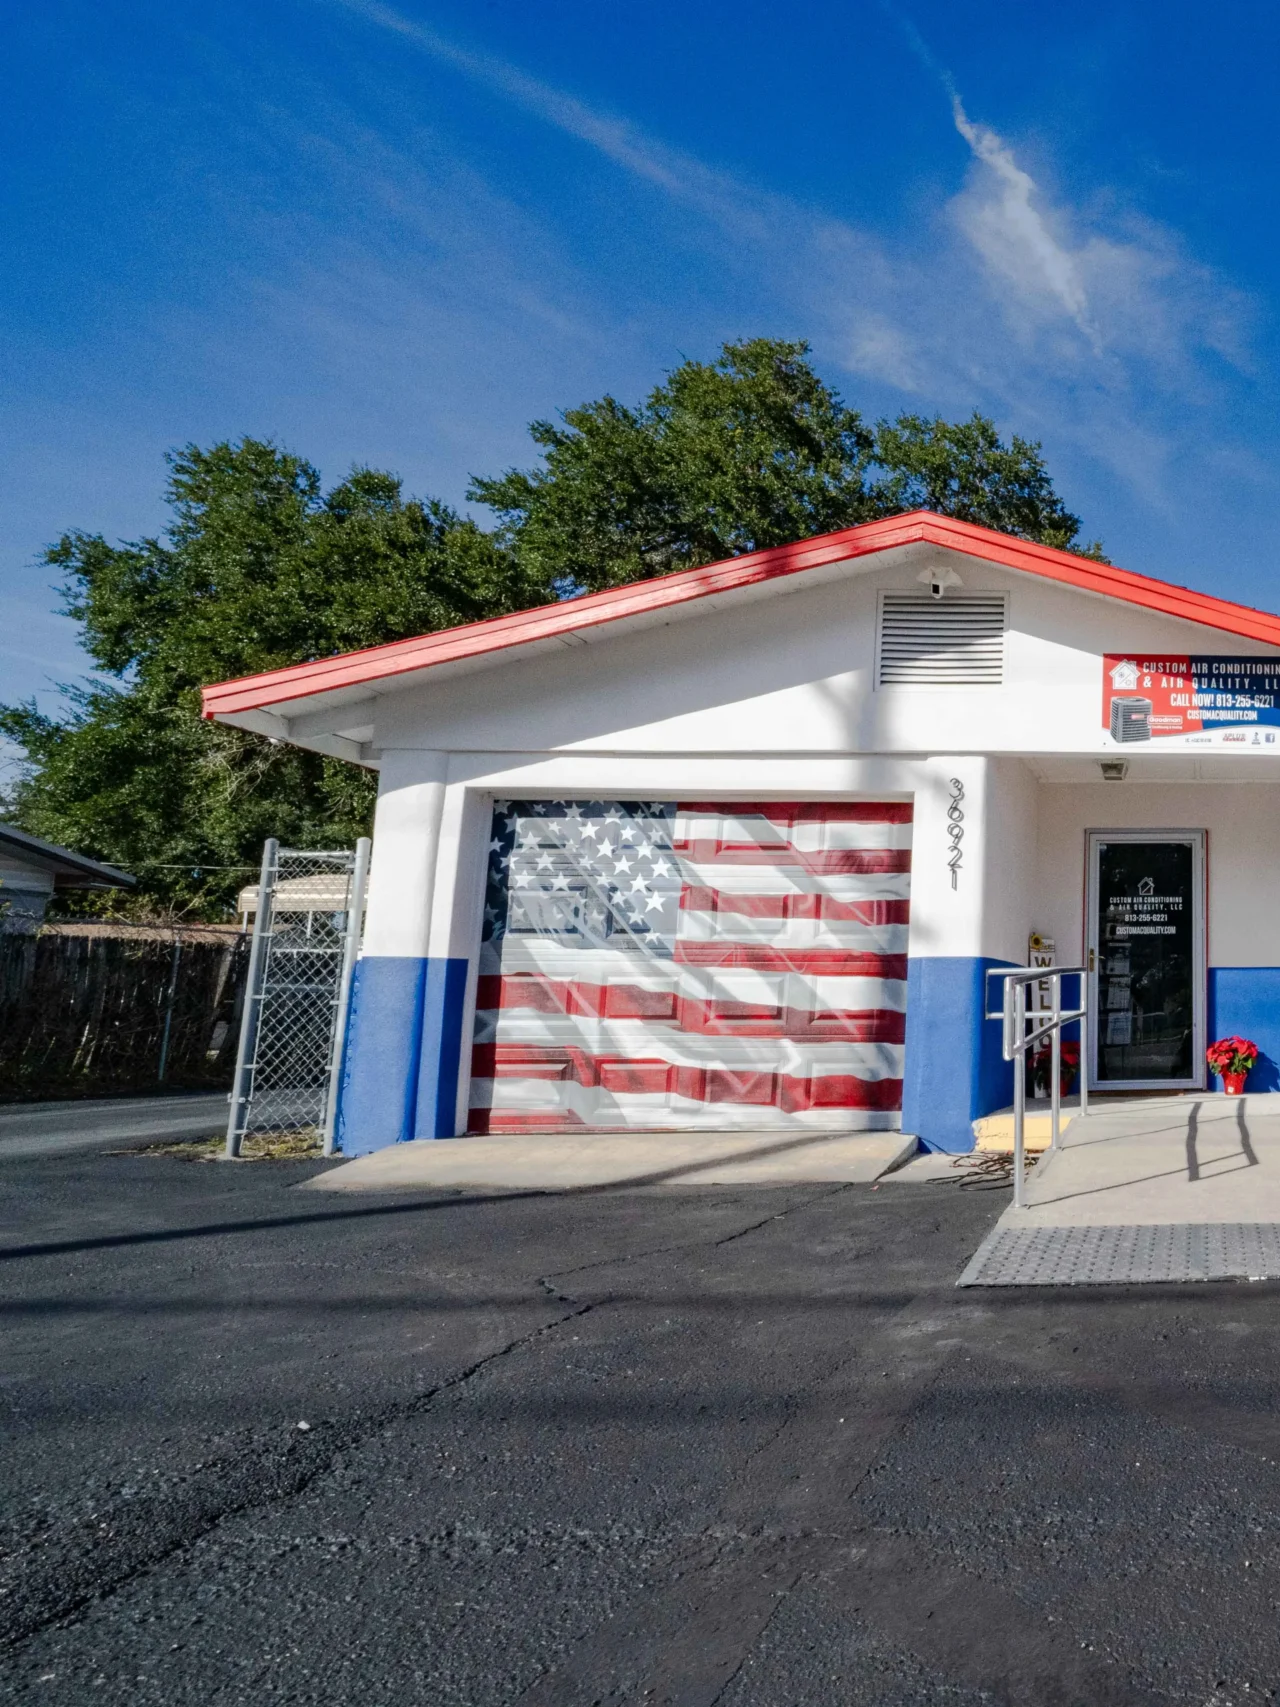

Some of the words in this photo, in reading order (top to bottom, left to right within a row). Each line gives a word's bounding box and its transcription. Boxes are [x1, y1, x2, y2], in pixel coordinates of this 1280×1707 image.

[1142, 662, 1187, 674] CUSTOM
[1191, 662, 1209, 675] AIR
[1142, 676, 1152, 688] &
[1161, 677, 1184, 689] AIR
[1192, 677, 1257, 691] QUALITY,
[1170, 693, 1190, 707] CALL
[1192, 693, 1215, 708] NOW!
[1216, 694, 1275, 708] 813-255-6221
[1186, 709, 1258, 721] CUSTOMACQUALITY.COM
[947, 777, 965, 891] 36921
[1109, 896, 1132, 904] CUSTOM
[1133, 896, 1142, 904] AIR
[1144, 896, 1183, 904] CONDITIONING
[1116, 926, 1177, 935] CUSTOMACQUALITY.COM
